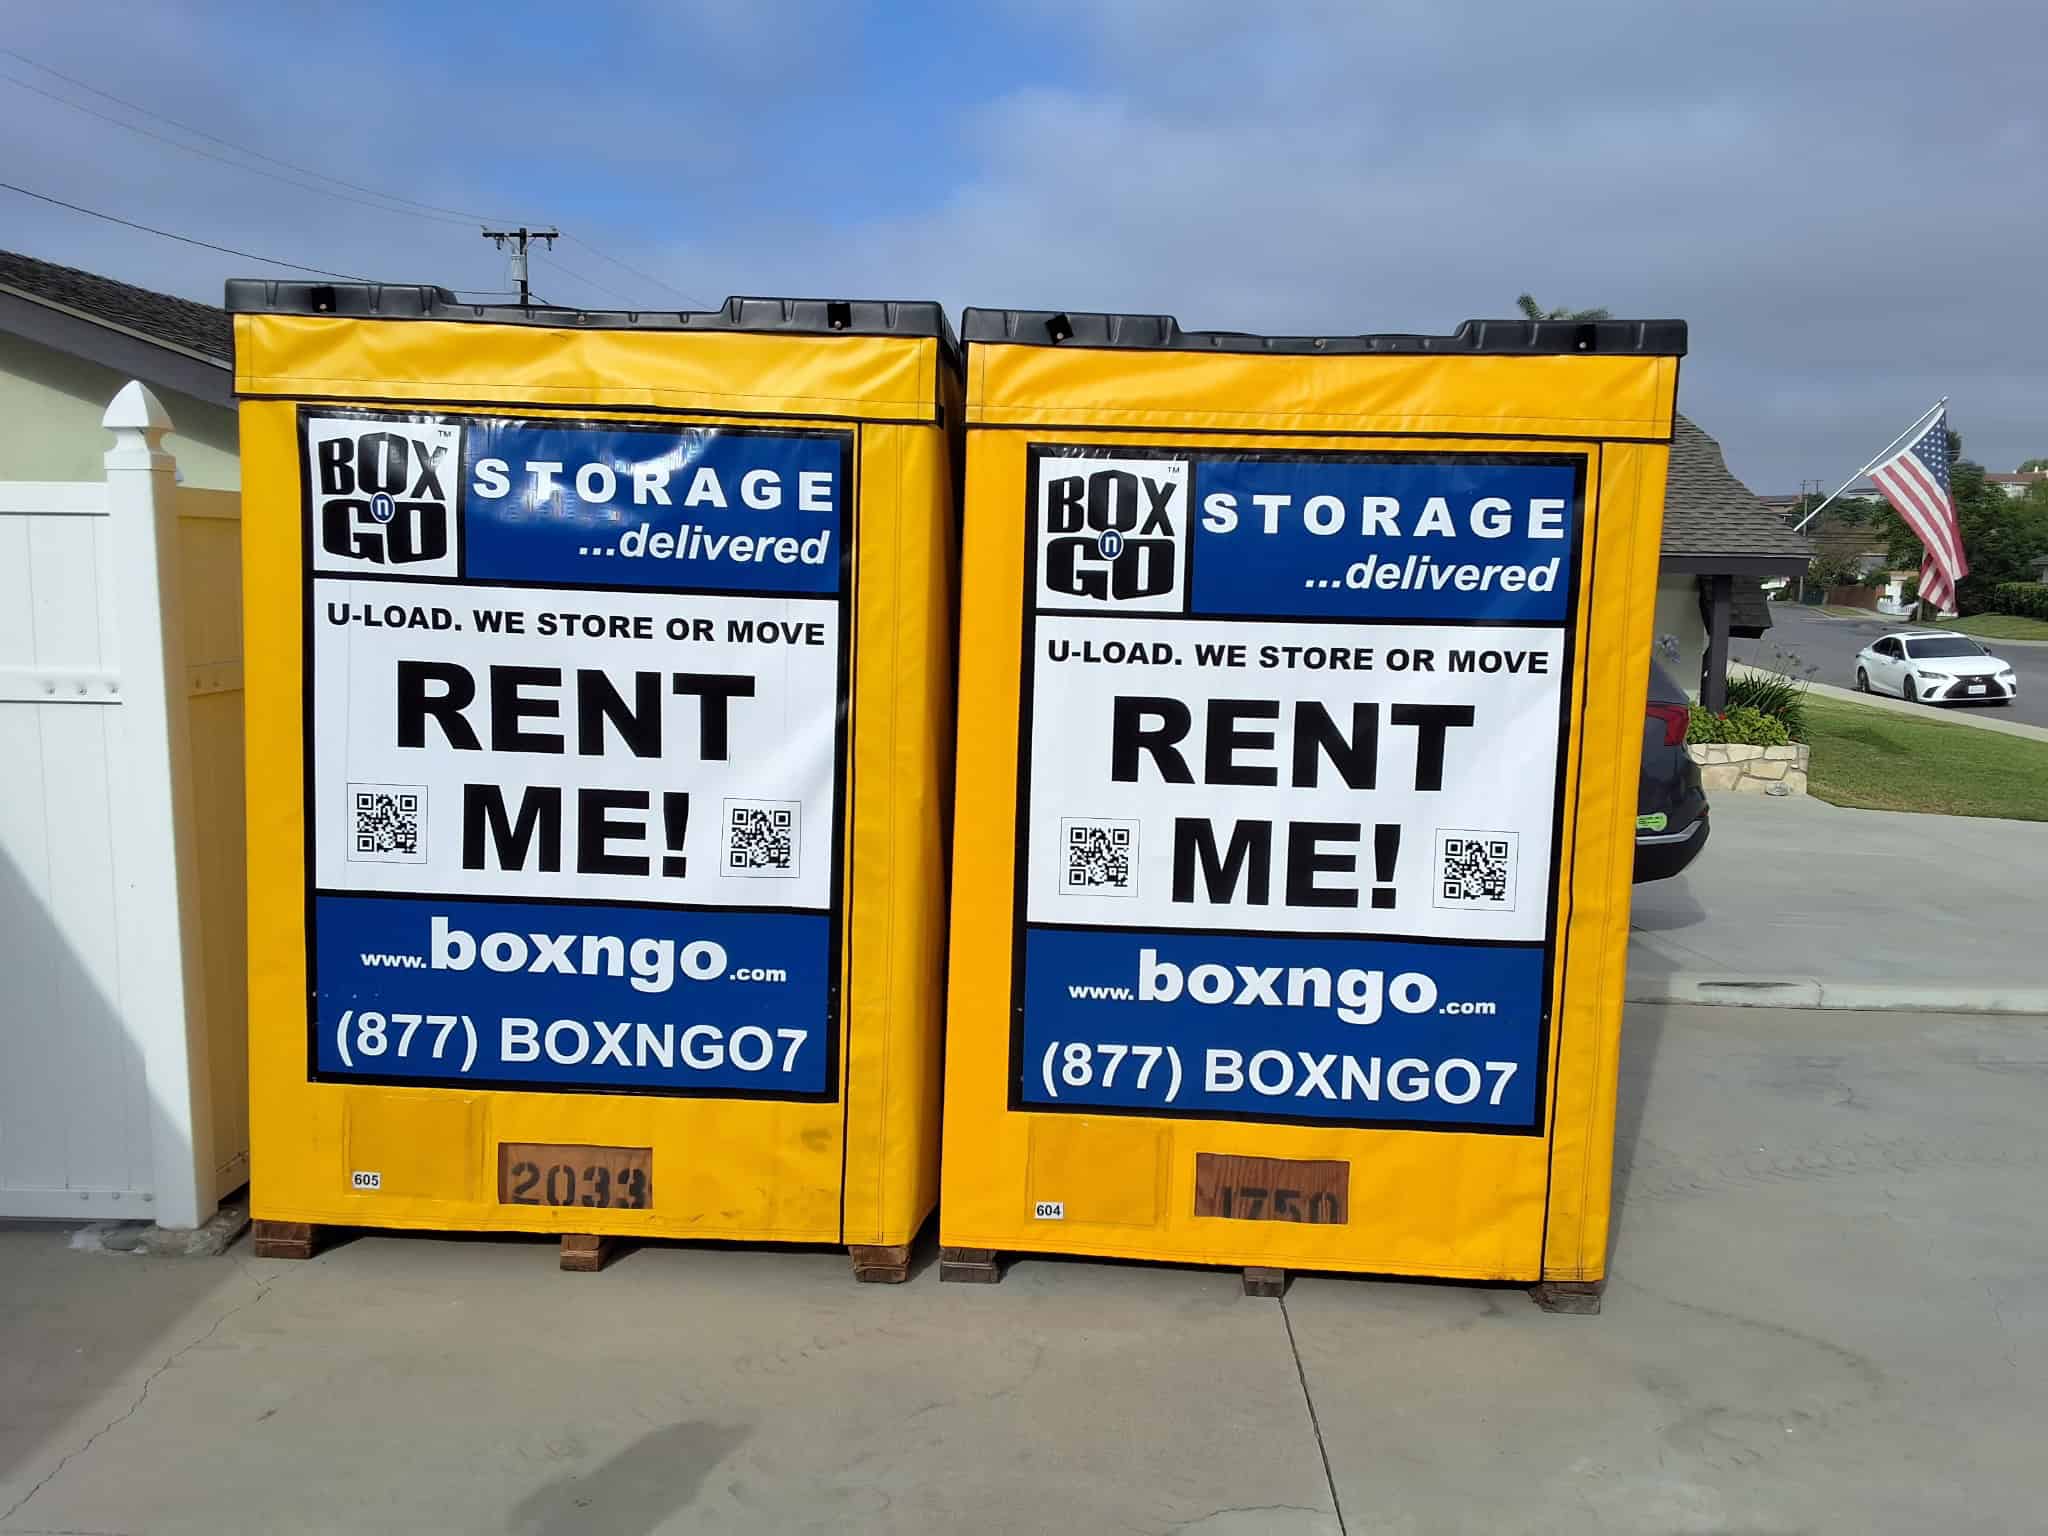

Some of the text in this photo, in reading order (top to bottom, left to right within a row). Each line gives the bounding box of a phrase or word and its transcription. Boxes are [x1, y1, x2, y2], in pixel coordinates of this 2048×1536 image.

[318, 431, 448, 501] BOX
[472, 456, 834, 513] STORAGE
[322, 498, 448, 565] GO
[1047, 469, 1177, 537] BOX
[1201, 493, 1565, 539] STORAGE
[579, 522, 831, 565] ...delivered
[1046, 536, 1176, 601] GO
[1305, 554, 1561, 592] ...delivered
[327, 602, 825, 646] U-LOAD. WE STORE OR MOVE
[1048, 639, 1549, 674] U-LOAD. WE STORE OR MOVE
[397, 660, 756, 761] RENT
[1111, 695, 1476, 792] RENT
[462, 783, 690, 879] ME!
[1172, 817, 1401, 910] ME!
[360, 916, 787, 993] www.boxngo.com
[1068, 948, 1496, 1025] www.boxngo.com
[336, 1010, 808, 1073] (877) BOXNGO7
[1042, 1041, 1518, 1105] (877) BOXNGO7
[354, 1174, 379, 1186] 605
[1036, 1204, 1061, 1216] 604
